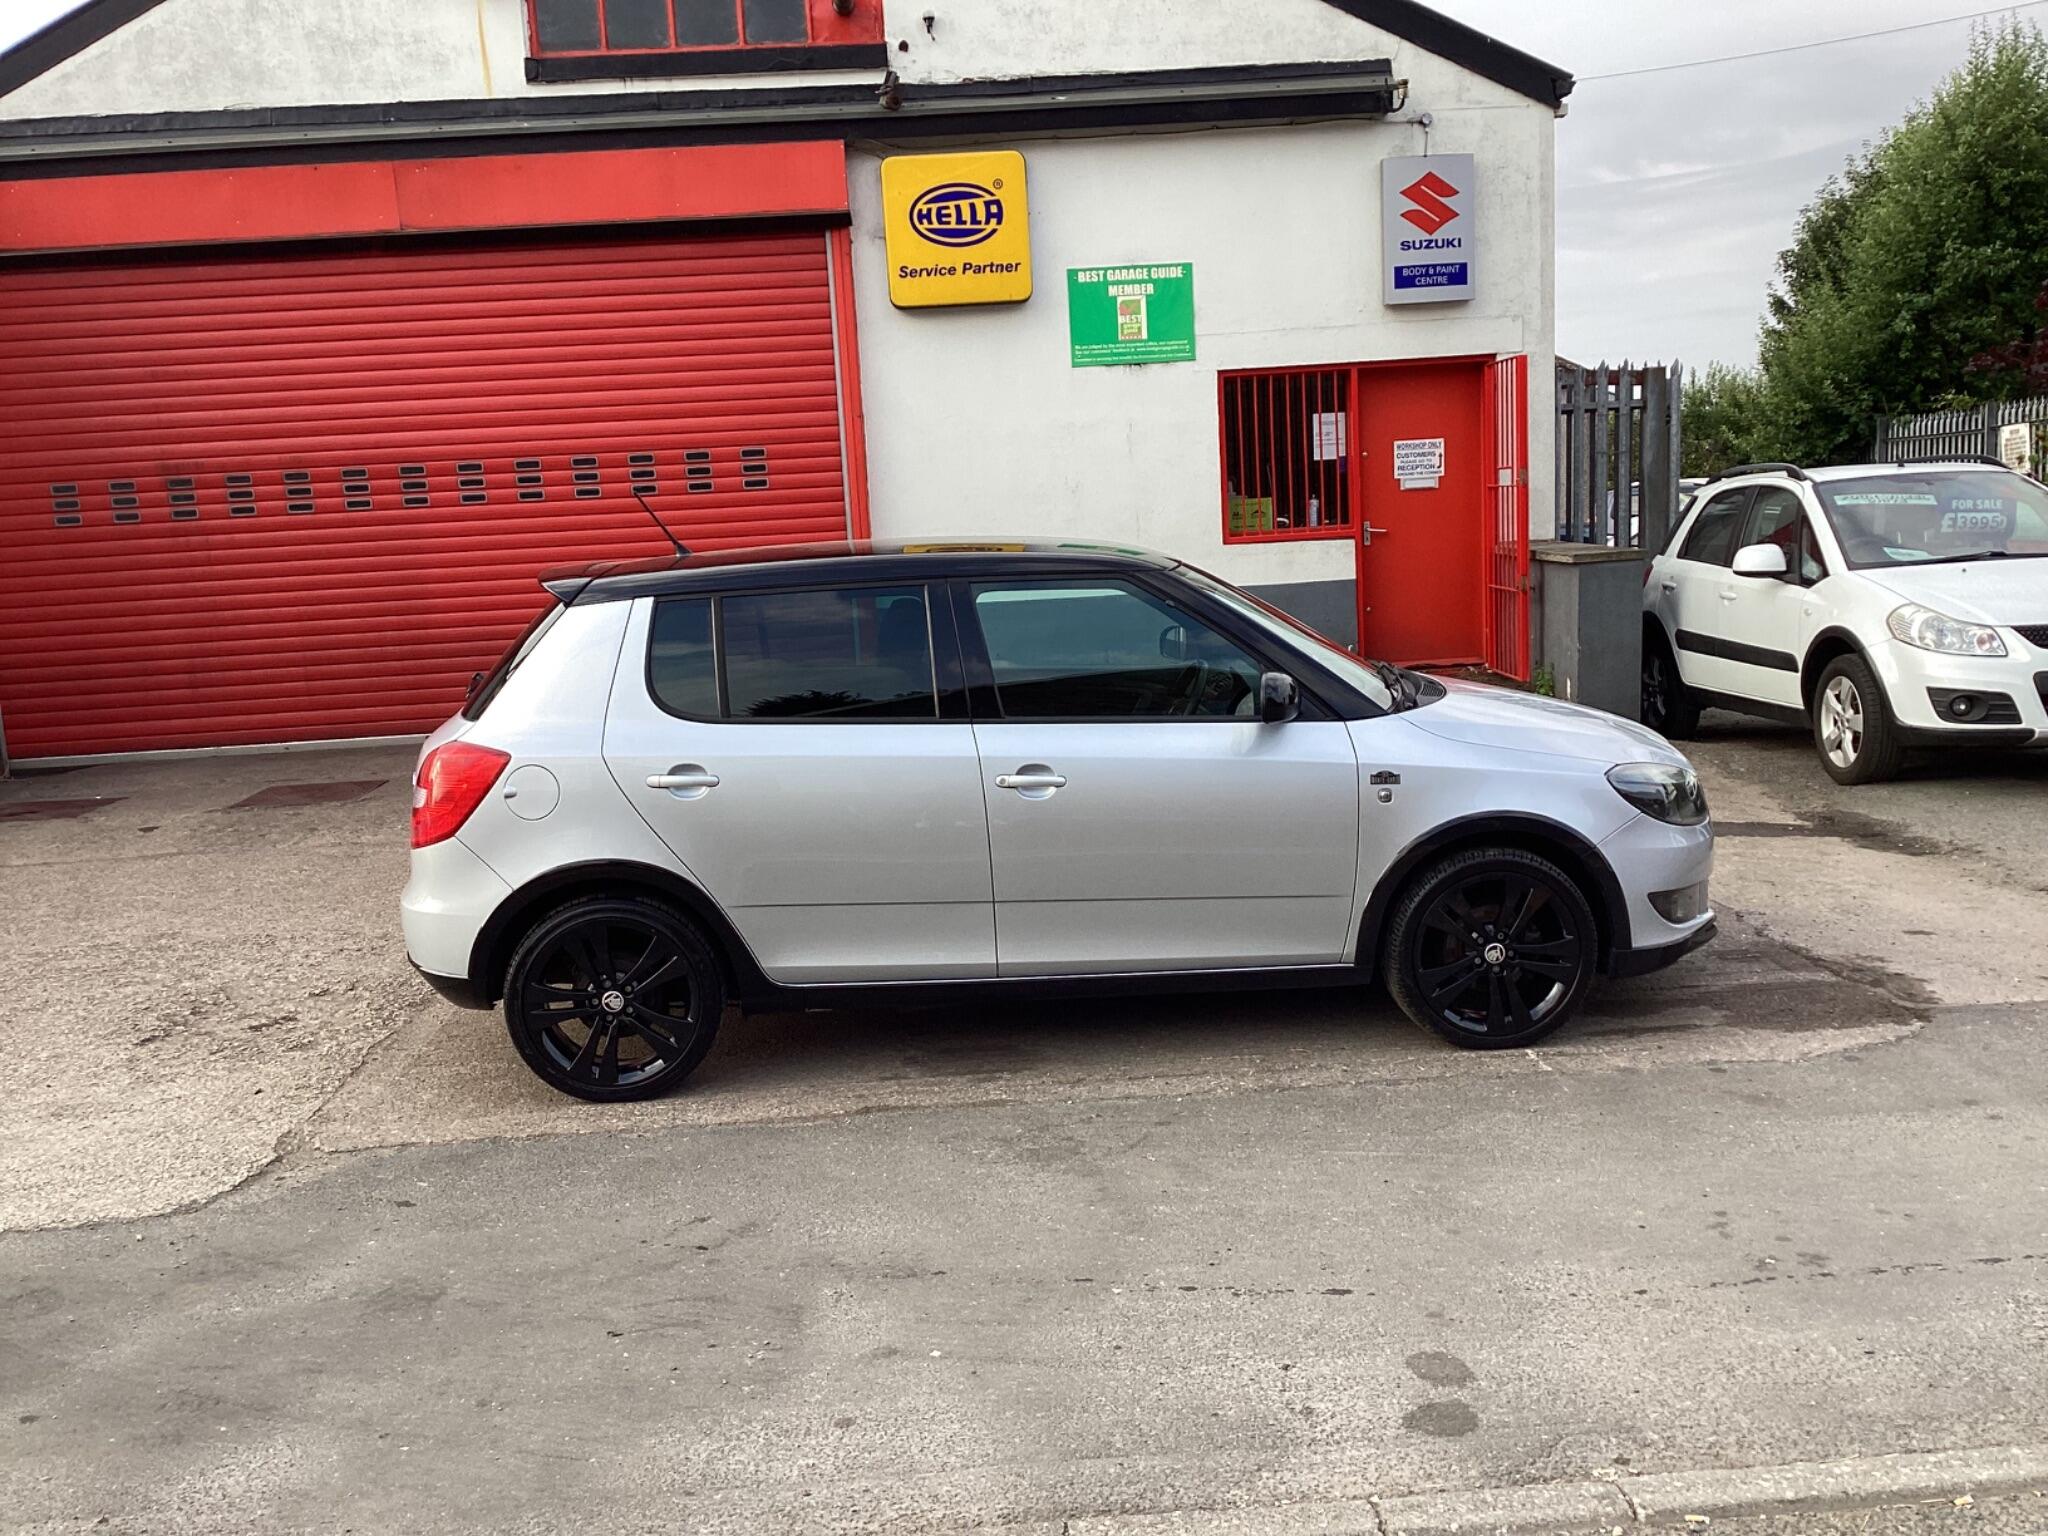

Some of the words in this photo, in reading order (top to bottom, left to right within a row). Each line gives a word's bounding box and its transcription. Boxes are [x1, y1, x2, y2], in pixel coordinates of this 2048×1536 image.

[917, 199, 1003, 226] HELLA
[1400, 237, 1462, 252] SUZUKI
[899, 264, 956, 279] Service
[962, 261, 1021, 275] Partner
[1078, 270, 1104, 283] BEST
[1106, 268, 1149, 281] GARAGE
[1151, 266, 1183, 279] GUIDE
[1402, 267, 1426, 276] BODY
[1429, 266, 1434, 275] &
[1436, 264, 1460, 274] PAINT
[1415, 275, 1448, 286] CENTRE
[1108, 283, 1154, 297] MEMBER
[1428, 441, 1442, 449] ONLY
[1952, 499, 1973, 510] FOR
[1975, 499, 2003, 509] SALE
